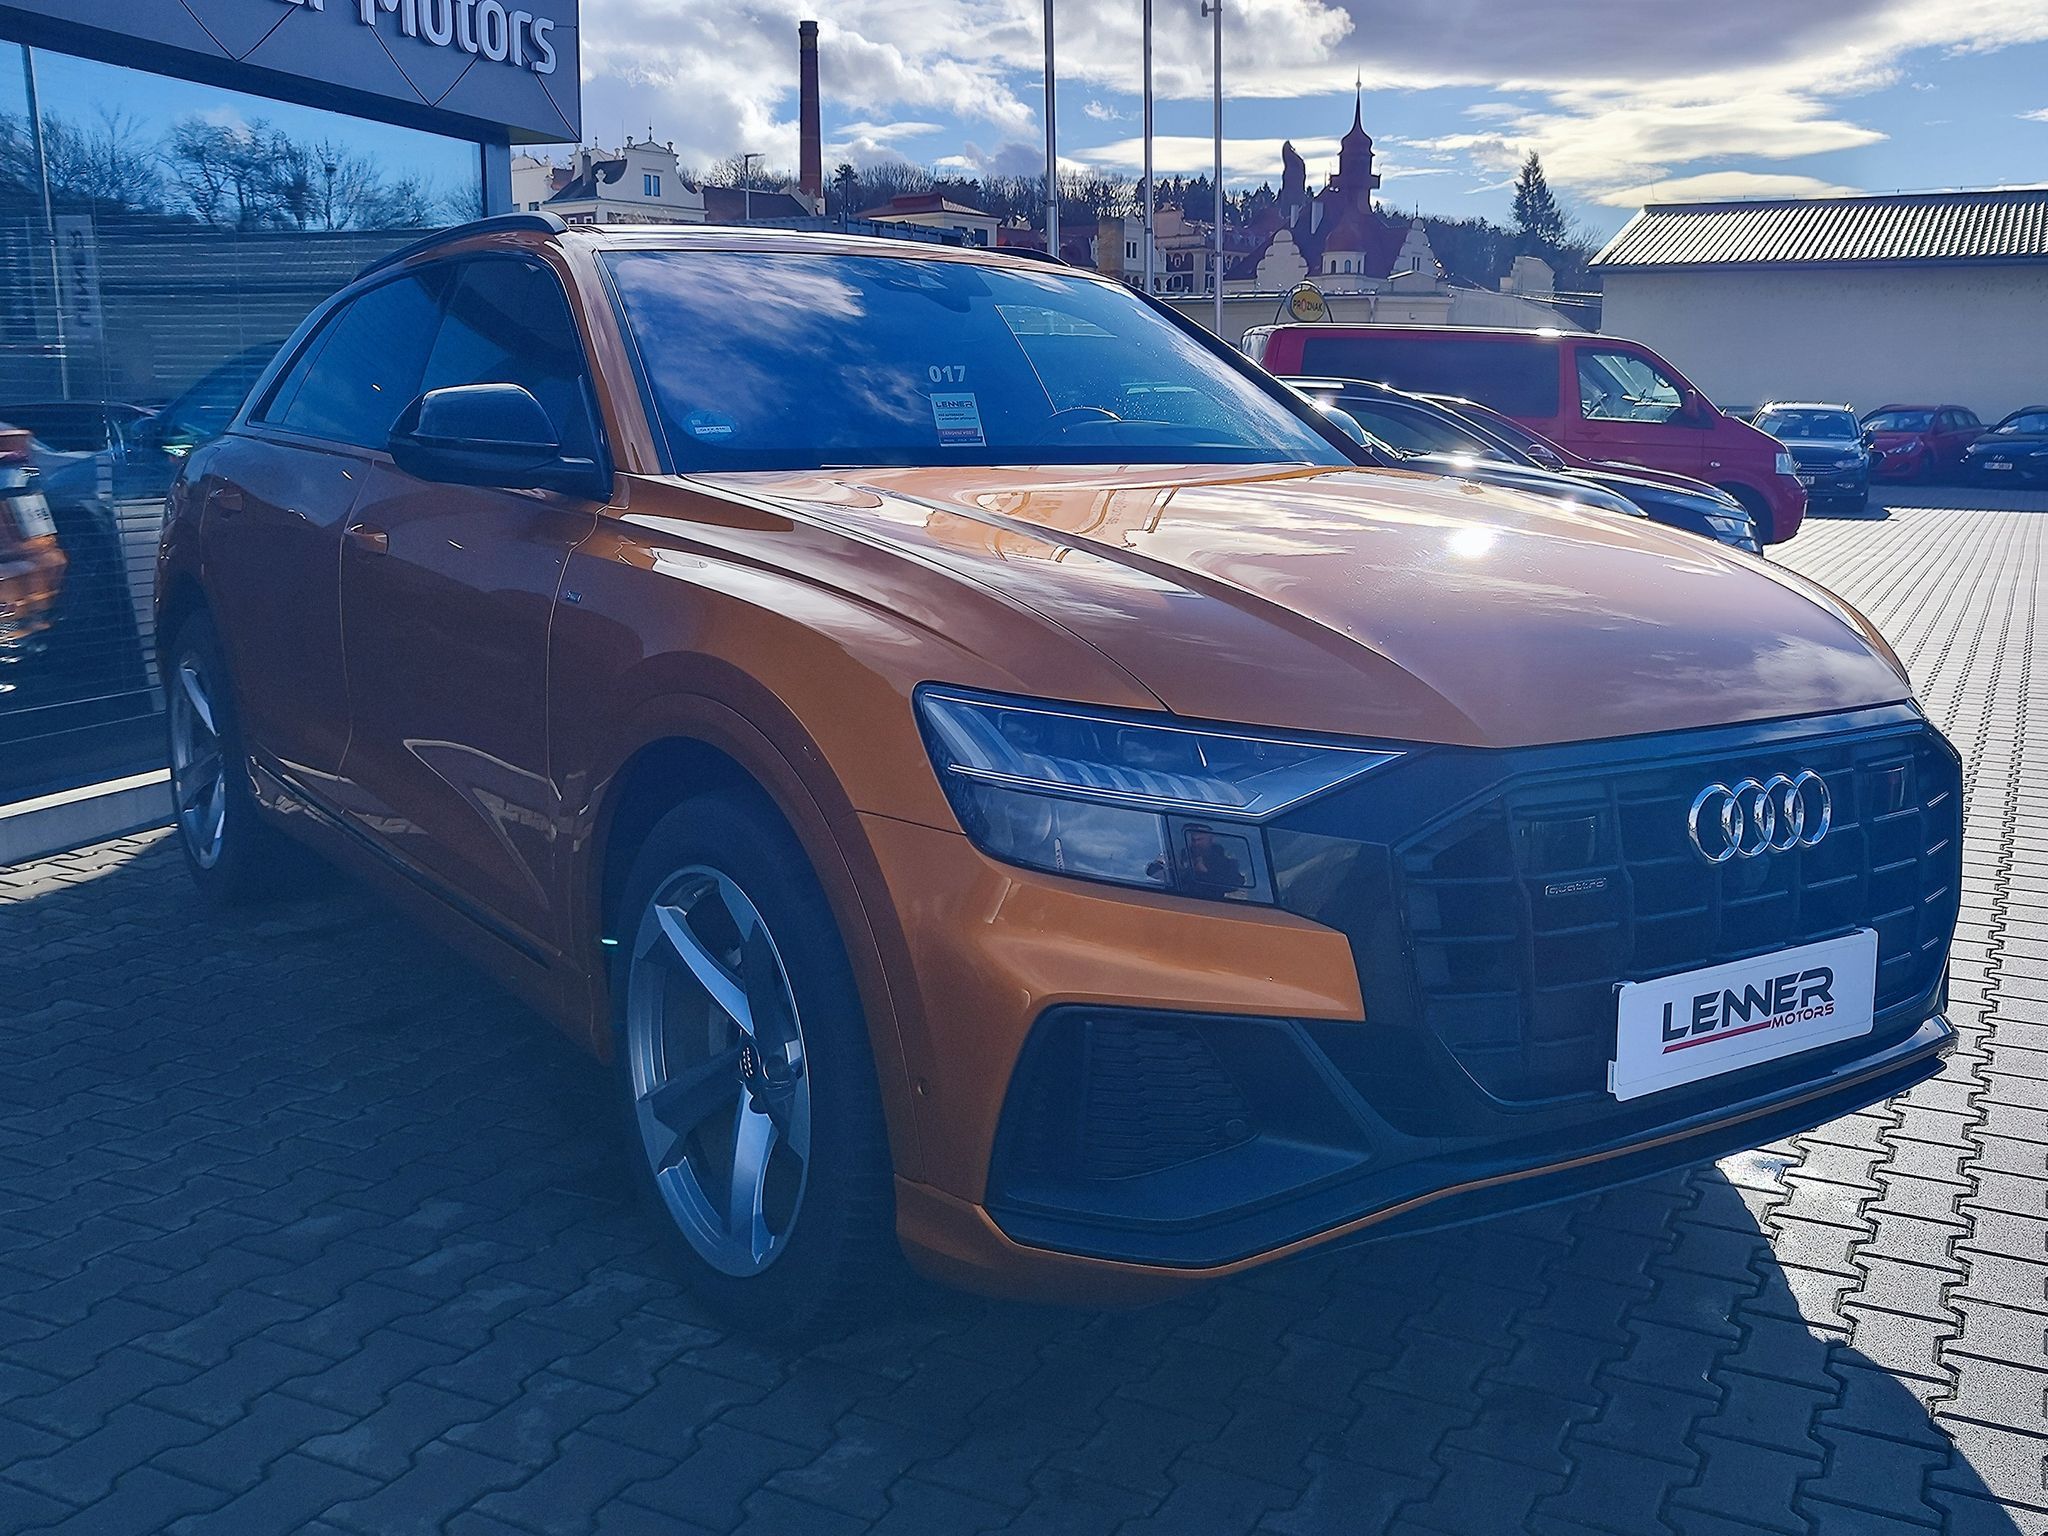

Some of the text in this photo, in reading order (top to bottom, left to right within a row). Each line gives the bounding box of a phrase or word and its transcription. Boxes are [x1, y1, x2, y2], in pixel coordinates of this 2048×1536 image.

[928, 365, 966, 383] 017
[935, 400, 975, 409] LENNER
[1547, 879, 1605, 895] quattro
[1661, 966, 1835, 1043] LENNER
[1770, 1002, 1835, 1030] MOTORS
